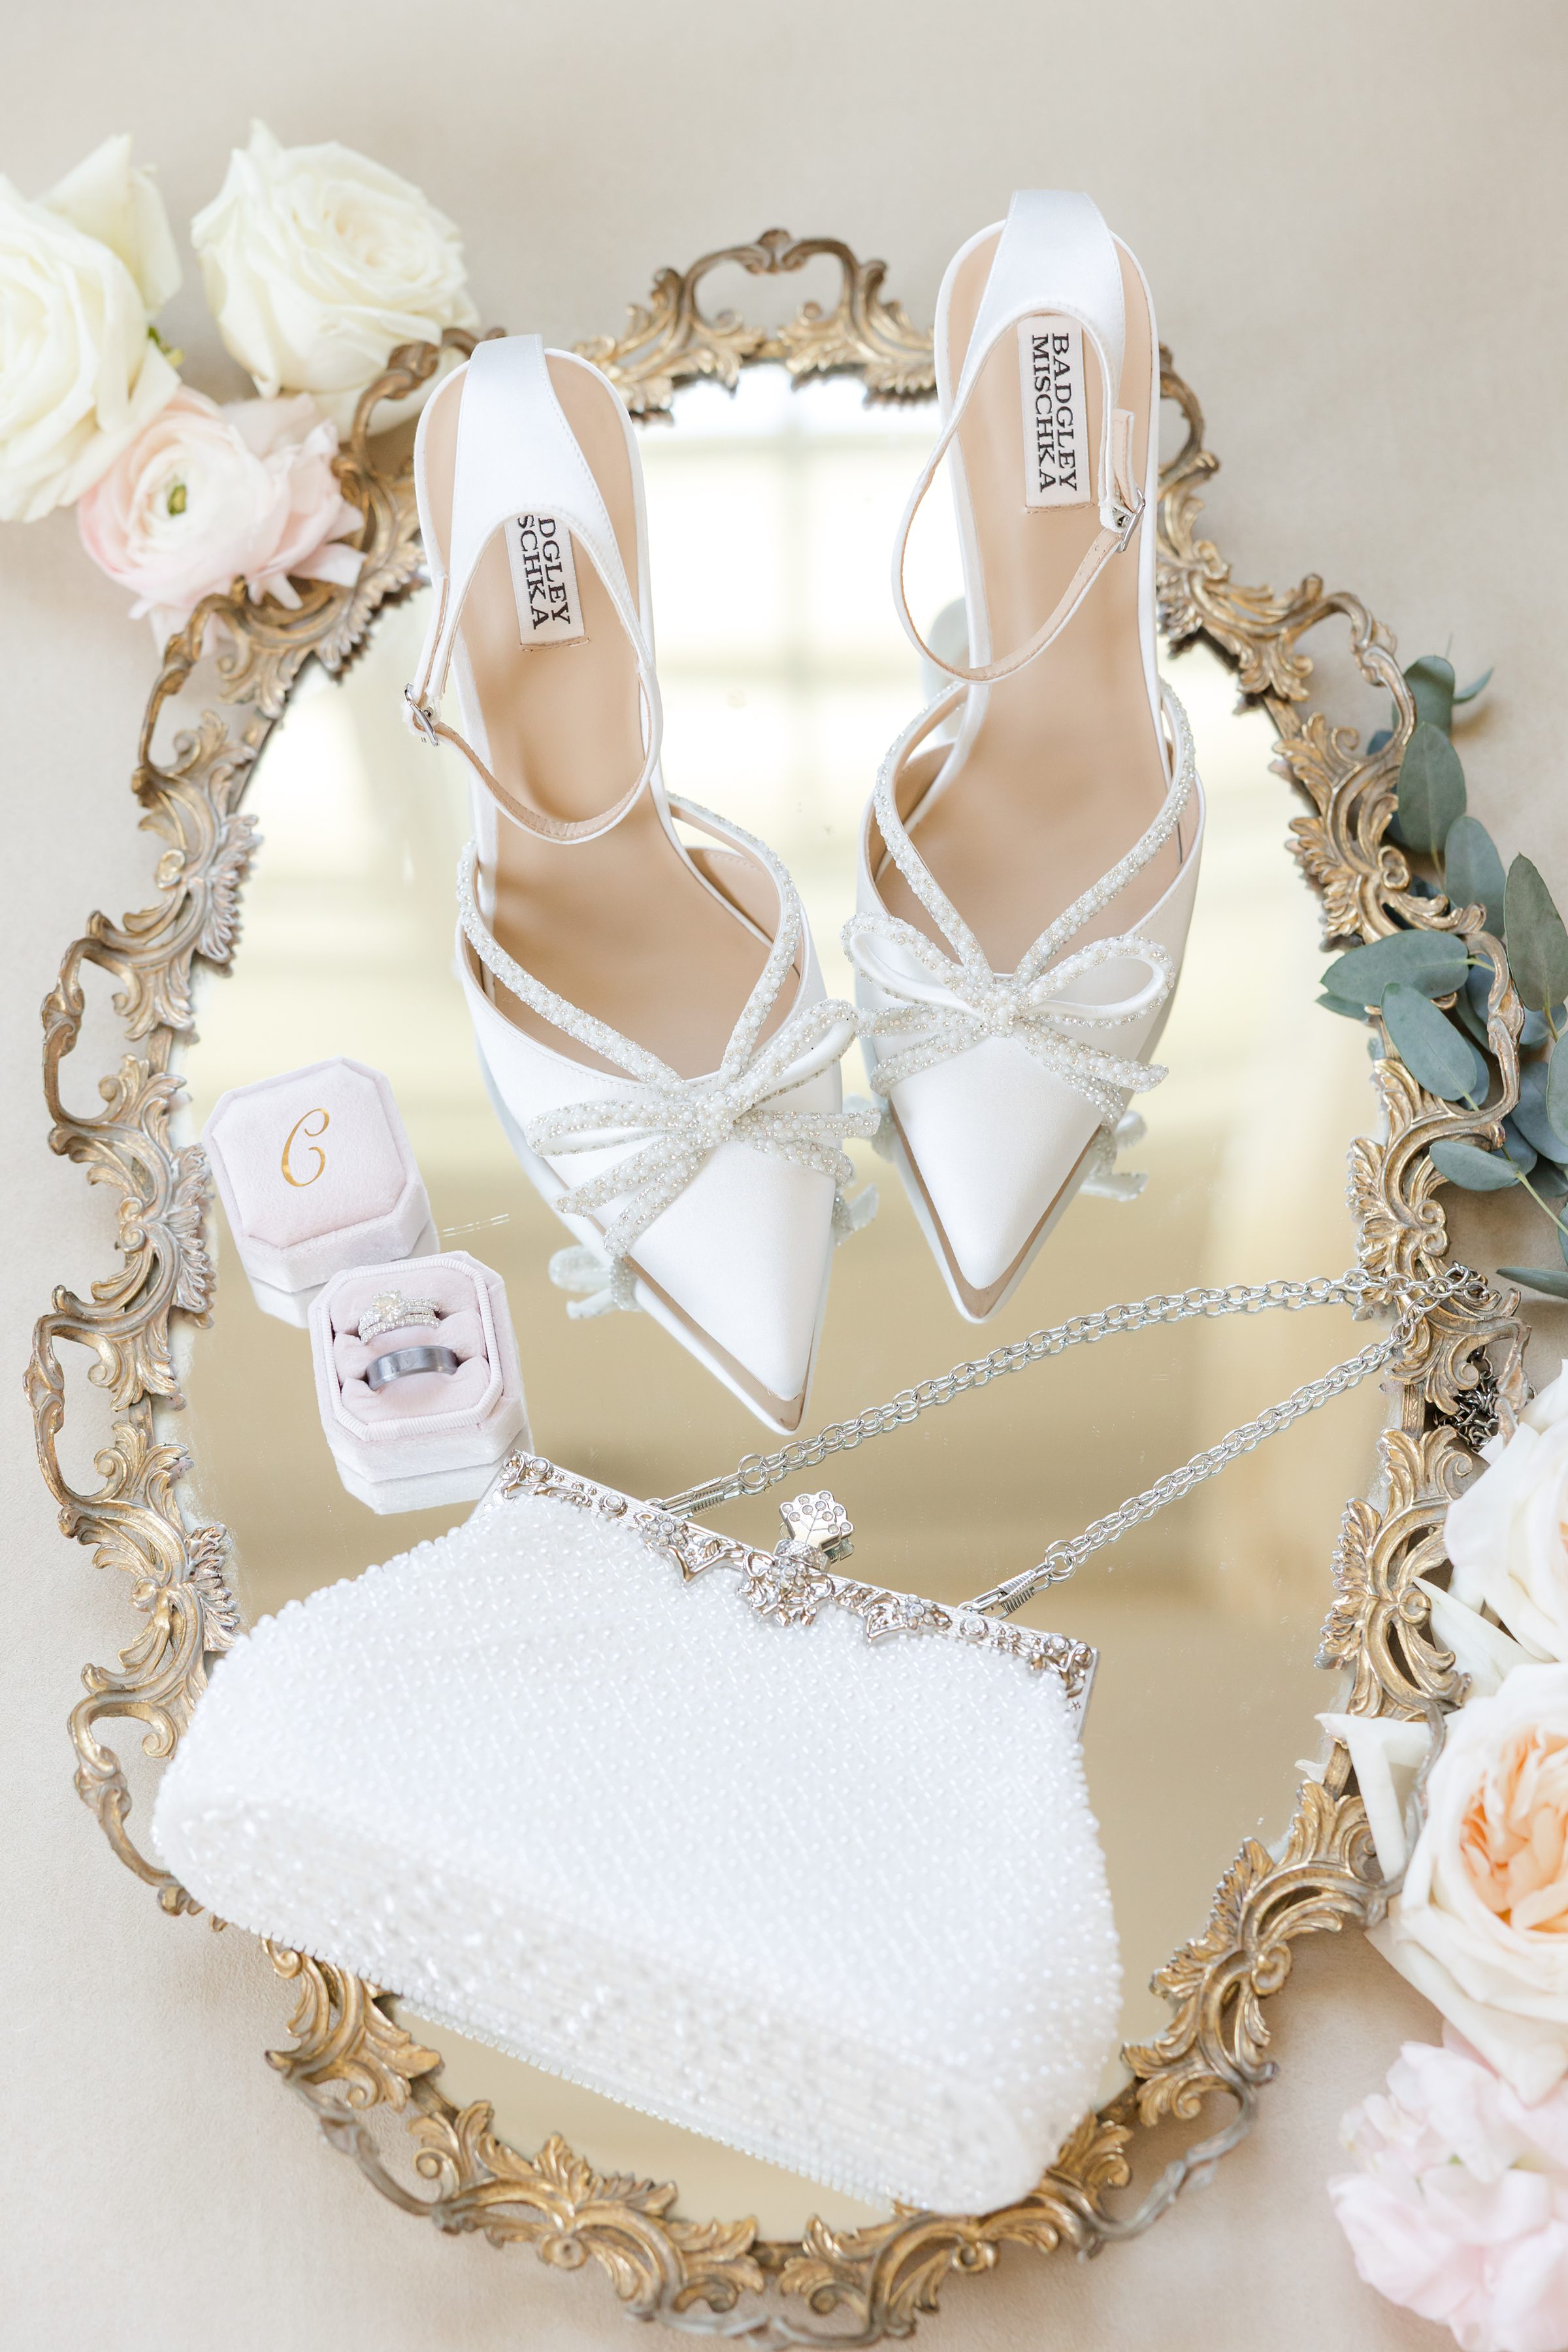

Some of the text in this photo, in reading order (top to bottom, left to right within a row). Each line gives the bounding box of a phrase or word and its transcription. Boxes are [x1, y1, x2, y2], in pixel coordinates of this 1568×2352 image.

[1032, 333, 1056, 493] MISCHKA
[1052, 333, 1077, 491] BADGLEY
[517, 514, 549, 630] SCHKA
[538, 517, 570, 624] DGLEY
